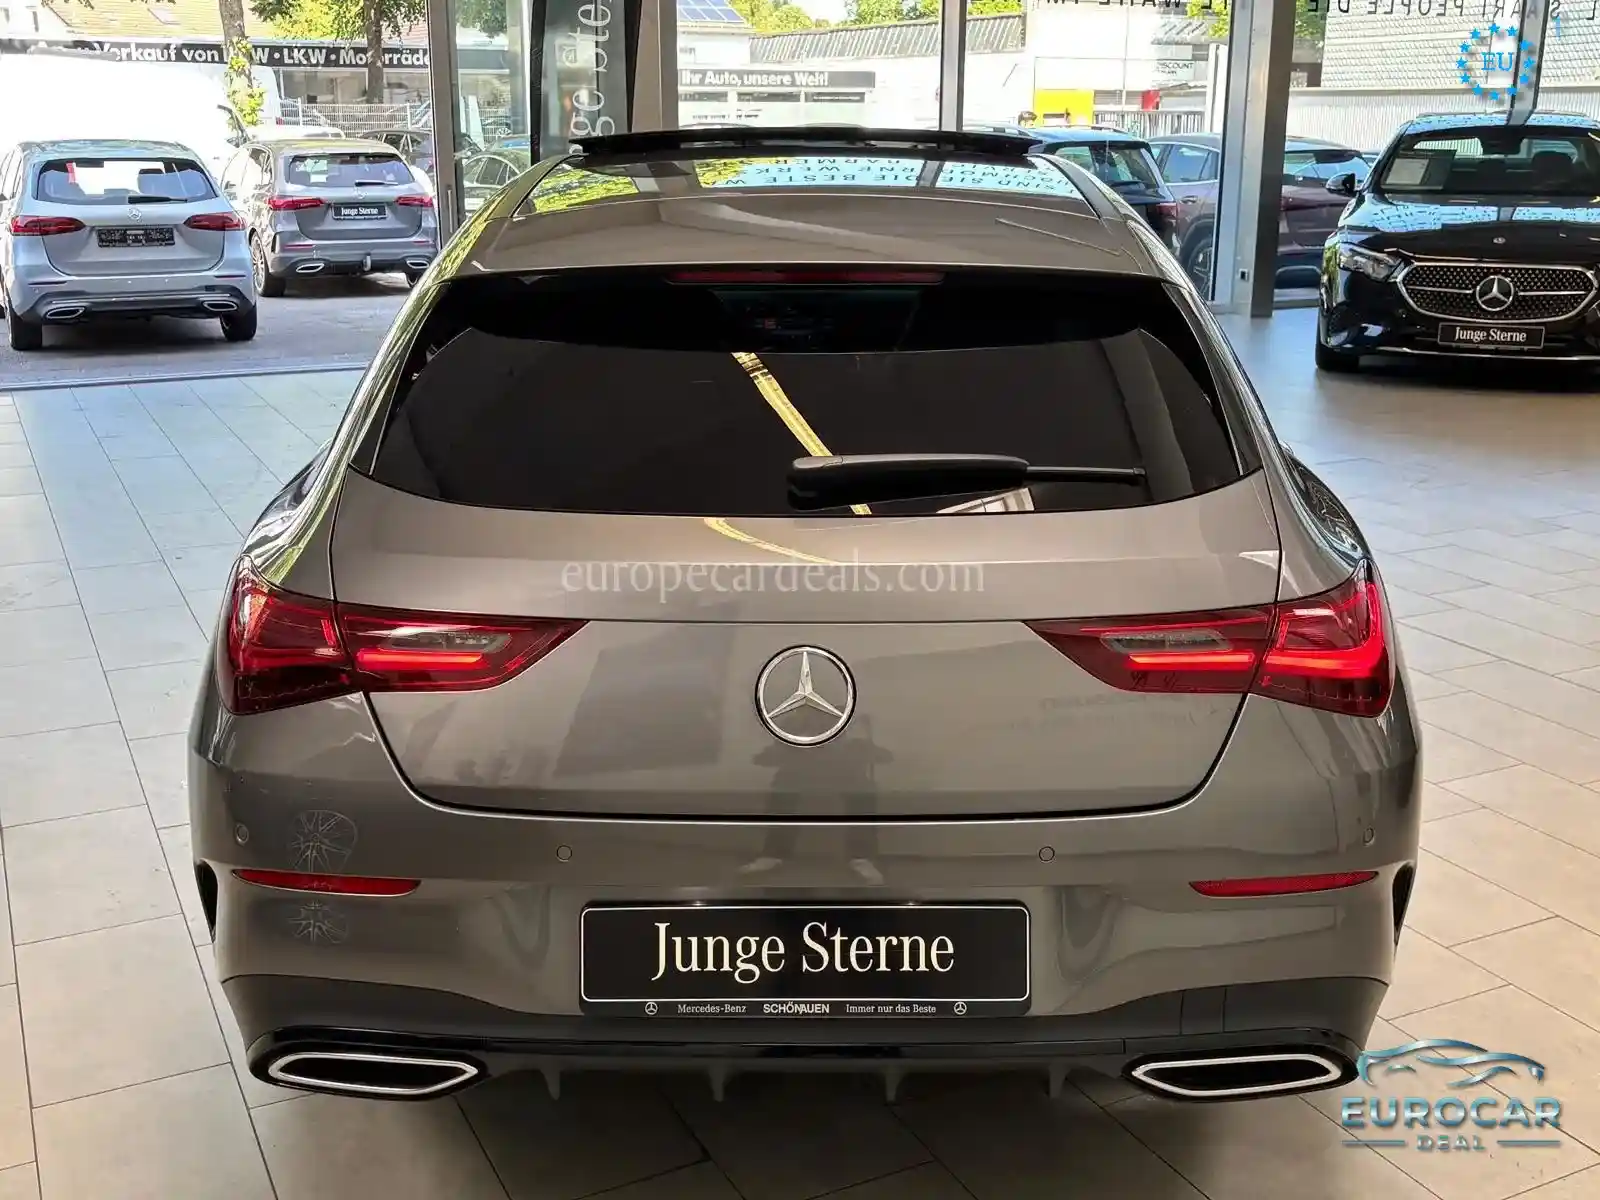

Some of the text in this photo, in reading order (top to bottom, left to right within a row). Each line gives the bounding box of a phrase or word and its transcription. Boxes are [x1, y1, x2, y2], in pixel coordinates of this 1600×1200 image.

[182, 48, 219, 62] von
[283, 47, 327, 65] LKW
[681, 71, 828, 88] Ihr Auto, unsere Welt!
[1454, 327, 1527, 343] Junge Sterne
[651, 921, 956, 984] Junge Sterne
[677, 1003, 747, 1014] Mercedes-Benz
[763, 1001, 831, 1015] SCHÖNAUEN
[845, 1004, 937, 1014] Immer nur das Beste
